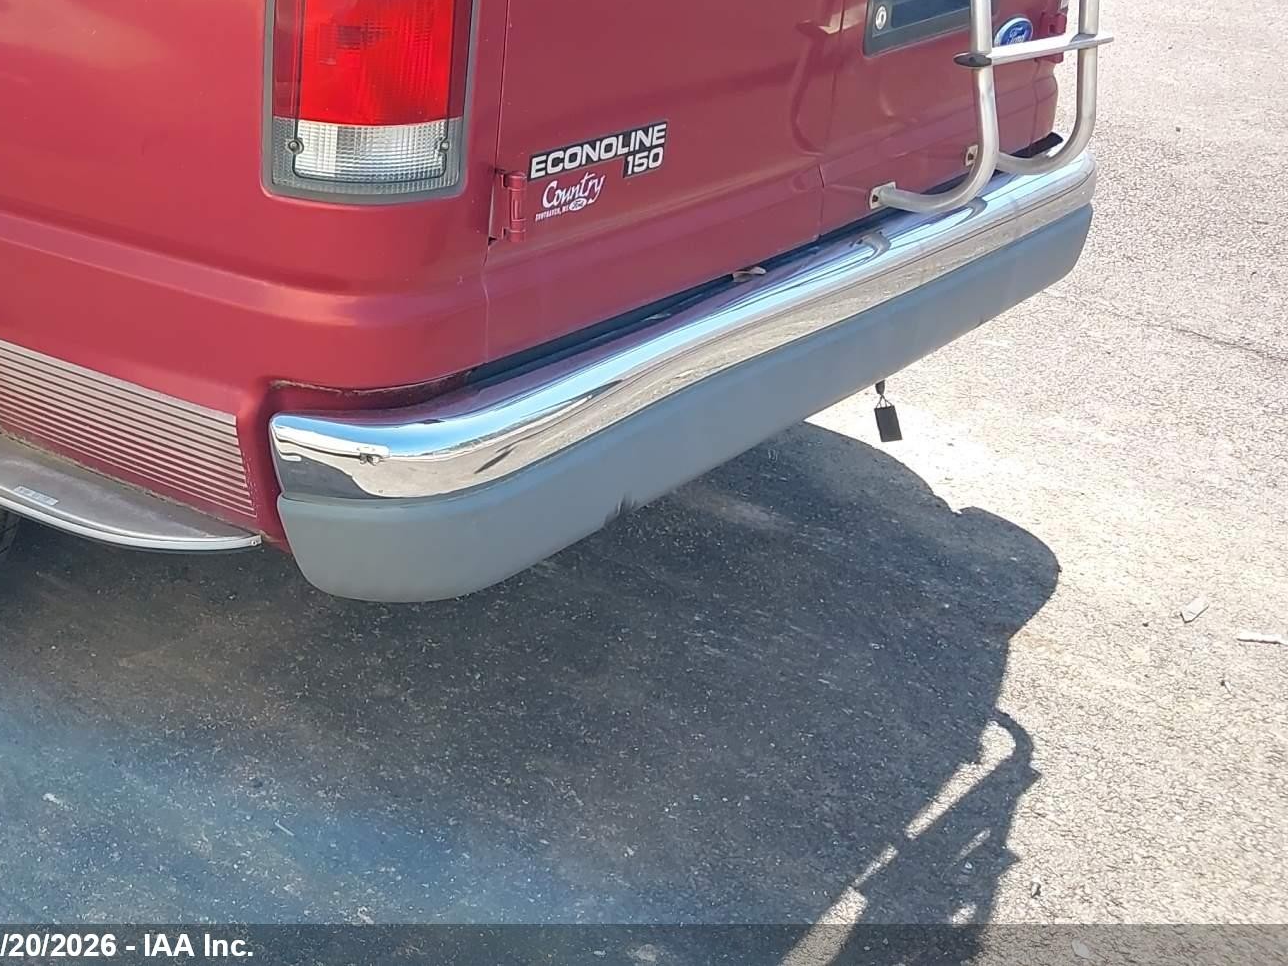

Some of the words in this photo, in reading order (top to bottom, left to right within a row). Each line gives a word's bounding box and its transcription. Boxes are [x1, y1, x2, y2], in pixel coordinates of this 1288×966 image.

[530, 123, 667, 179] ECONOLINE
[626, 146, 664, 175] 150
[542, 172, 606, 208] Country
